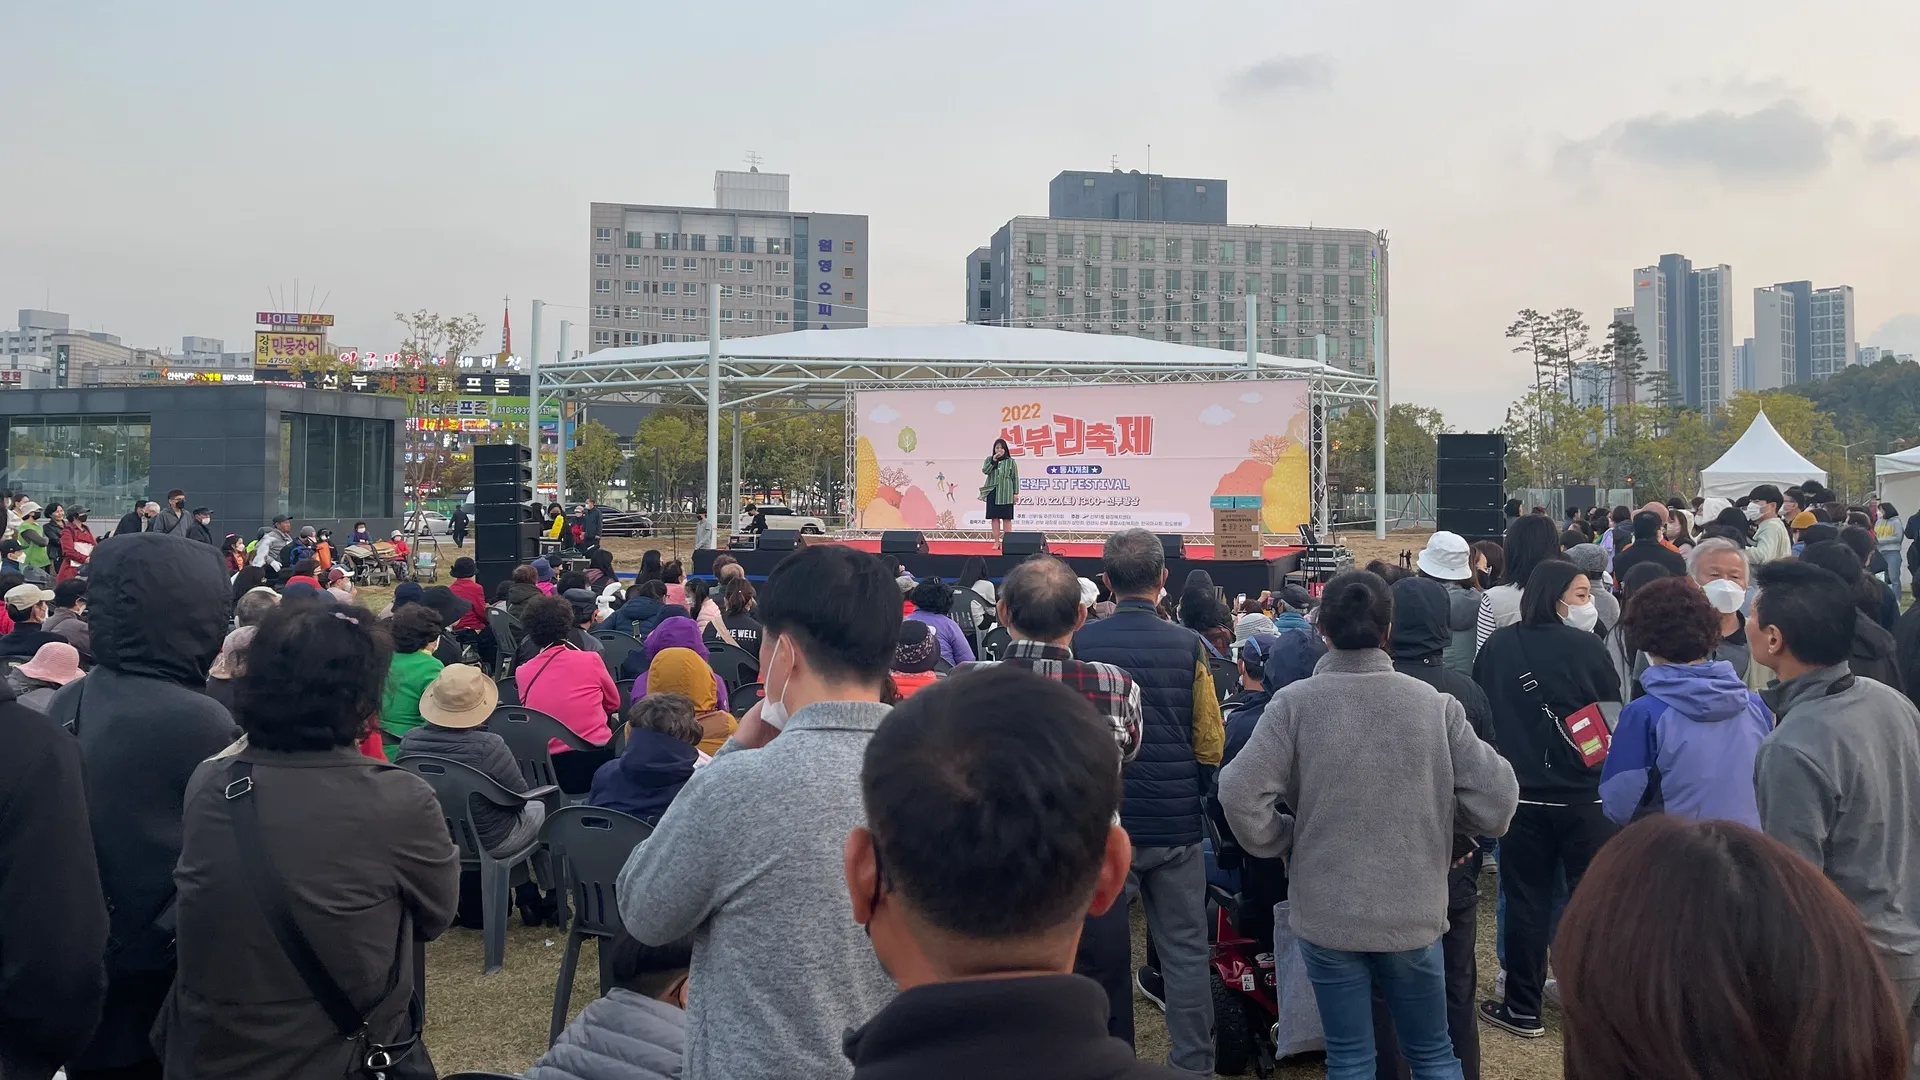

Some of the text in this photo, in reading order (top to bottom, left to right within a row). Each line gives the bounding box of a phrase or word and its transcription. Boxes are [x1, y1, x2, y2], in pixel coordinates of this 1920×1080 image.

[258, 313, 299, 325] 나이트
[271, 336, 319, 356] 민물장어
[1002, 403, 1041, 423] 2022
[1000, 414, 1153, 456] 선부리축제
[1020, 478, 1130, 490] 단원구 IT FESTIVAL
[738, 629, 757, 639] WELL
